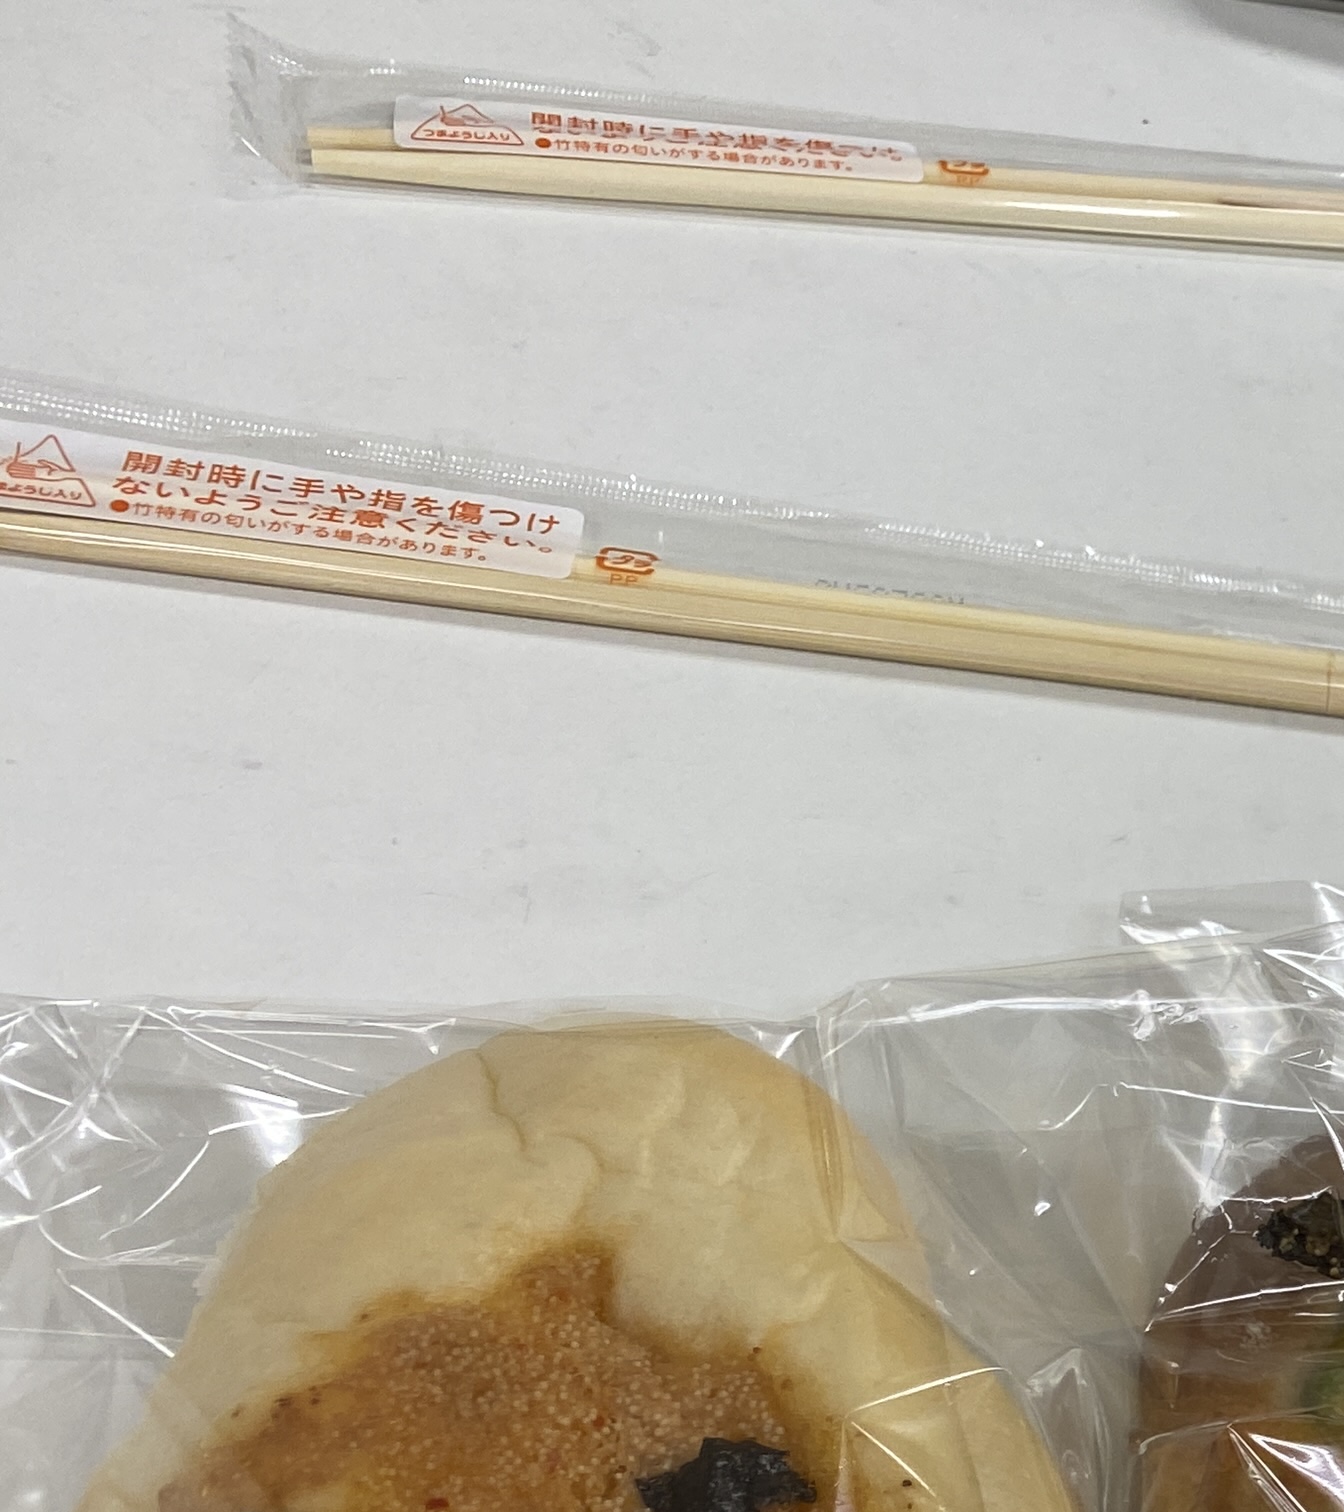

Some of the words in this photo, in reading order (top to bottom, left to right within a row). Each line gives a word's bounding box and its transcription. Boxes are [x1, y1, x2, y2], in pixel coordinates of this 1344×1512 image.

[110, 475, 553, 556] ないようご注意ください。
[120, 450, 560, 536] 開封時に手や指を傷つけ
[132, 502, 488, 563] 竹特有の匂いがする場合があります。
